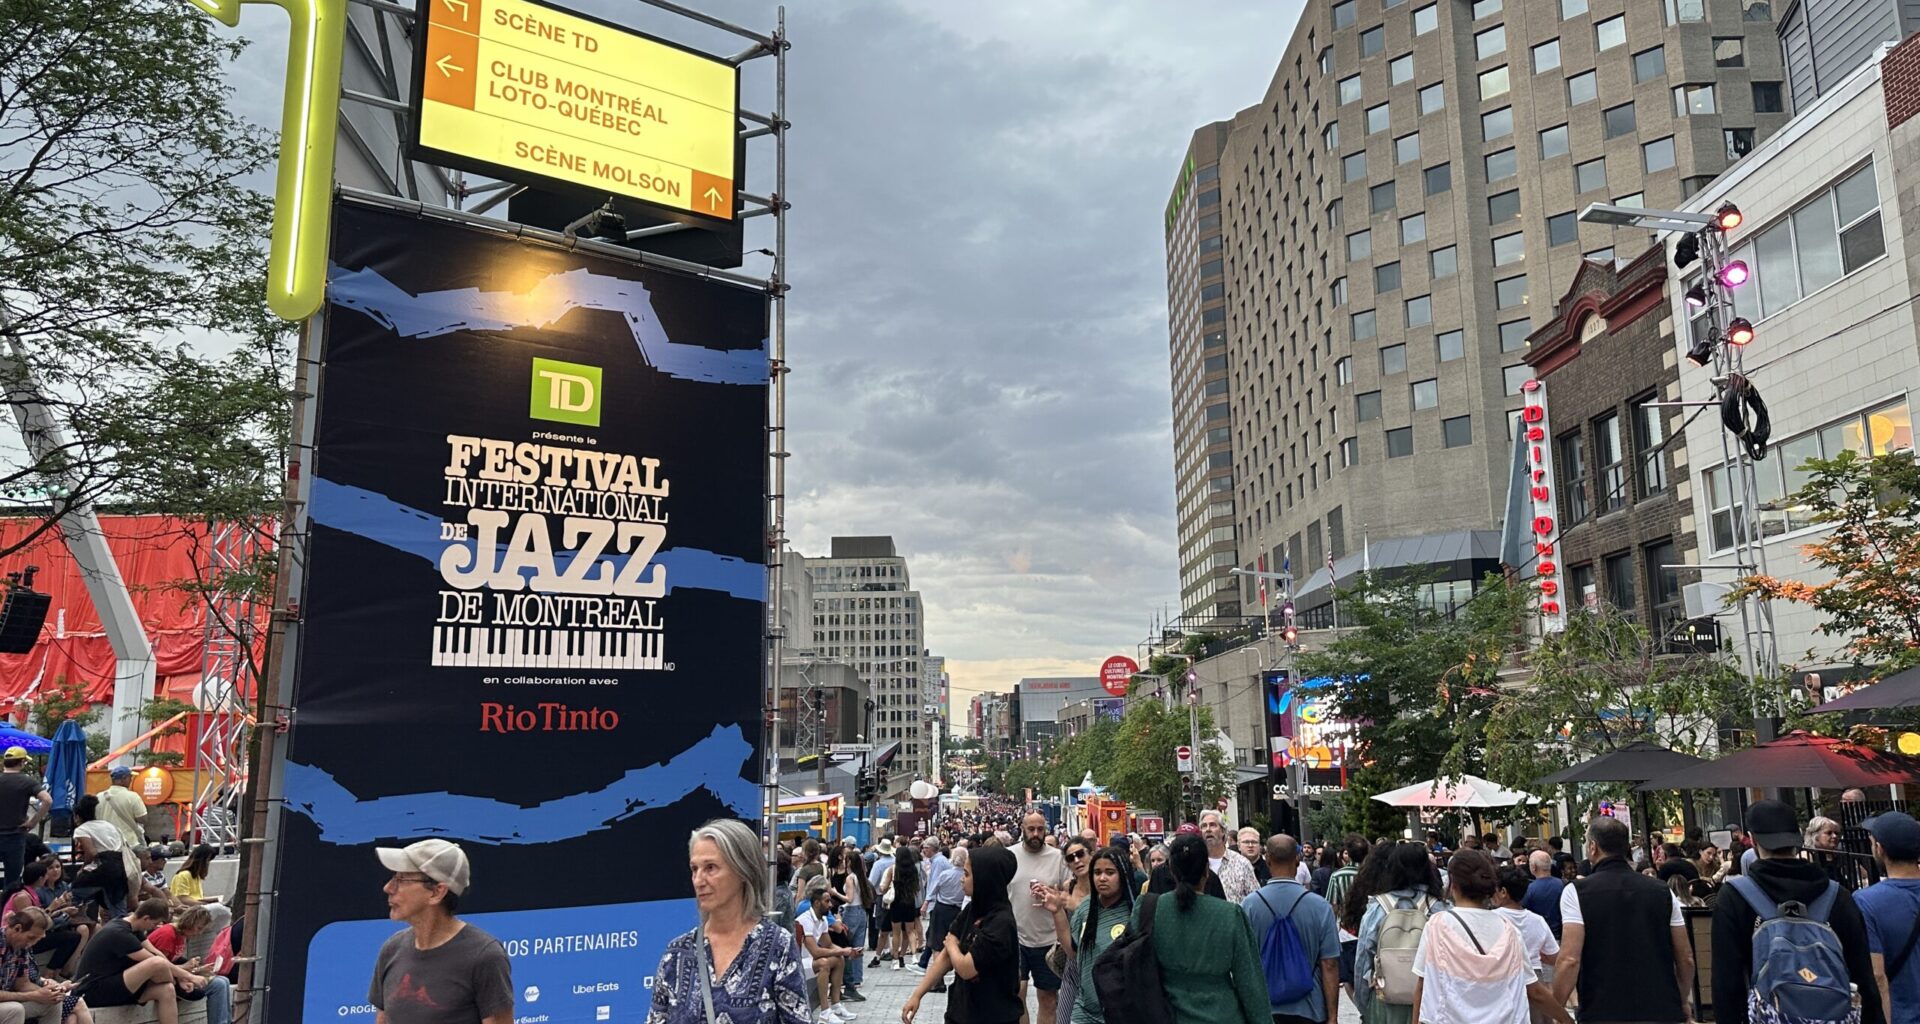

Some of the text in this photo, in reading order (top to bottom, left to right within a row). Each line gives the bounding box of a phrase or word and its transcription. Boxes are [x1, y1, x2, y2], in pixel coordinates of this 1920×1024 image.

[494, 8, 598, 53] SCÈNE TD
[489, 81, 641, 136] LOTO-QUÉBEC
[490, 60, 668, 125] CLUB MONTRÉAL
[515, 141, 681, 198] SCÈNE MOLSON
[539, 370, 594, 412] TD
[532, 430, 597, 445] présente le
[1524, 405, 1549, 502] Dairy
[444, 434, 669, 497] FESTIVAL
[443, 476, 669, 524] INTERNATIONAL
[440, 508, 667, 598] DE JAZZ
[1533, 515, 1559, 615] Queen
[437, 590, 483, 624] DE
[483, 675, 619, 686] en collaboration avec
[664, 661, 675, 671] MD
[534, 930, 639, 956] PARTENAIRES
[350, 1004, 377, 1015] ROGE
[572, 982, 619, 995] Uber Eats
